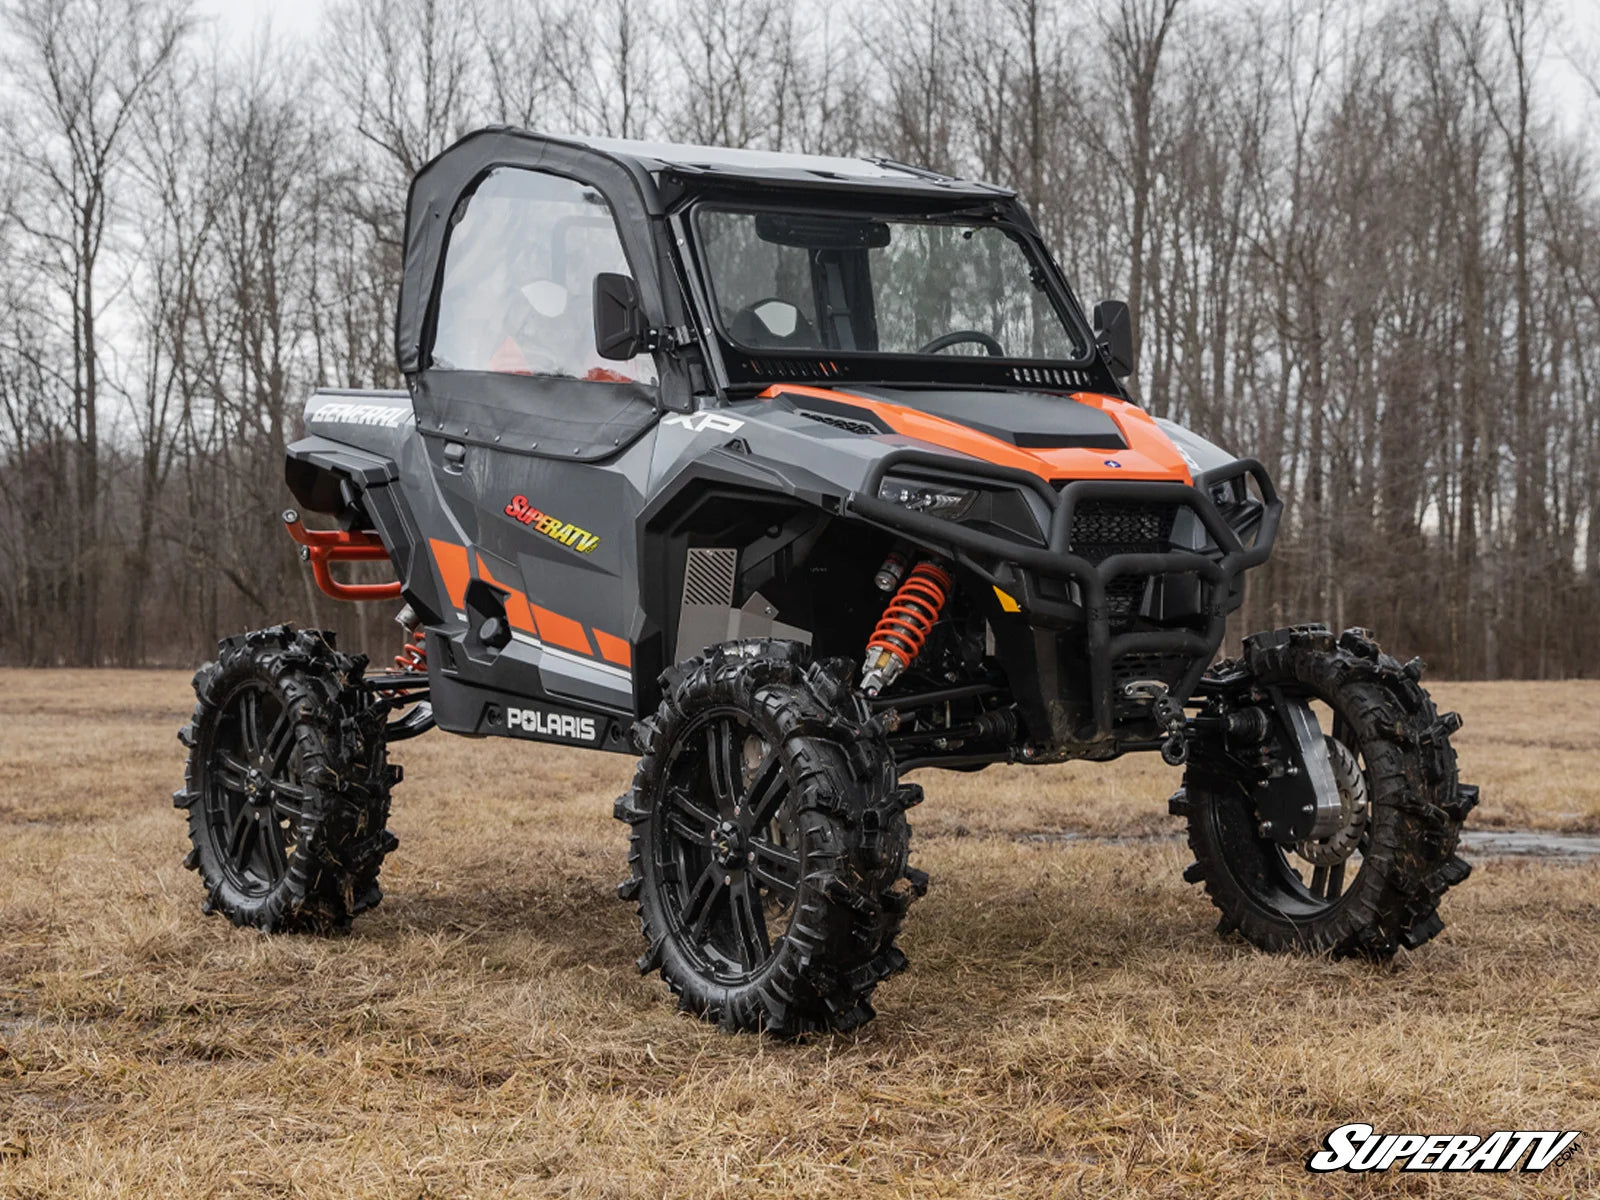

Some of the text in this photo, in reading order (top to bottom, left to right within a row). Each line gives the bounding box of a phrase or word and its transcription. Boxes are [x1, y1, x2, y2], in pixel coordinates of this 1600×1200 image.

[311, 403, 410, 428] GENERAL
[662, 410, 745, 434] XP
[504, 494, 600, 553] SUPERATV
[507, 707, 596, 740] POLARIS
